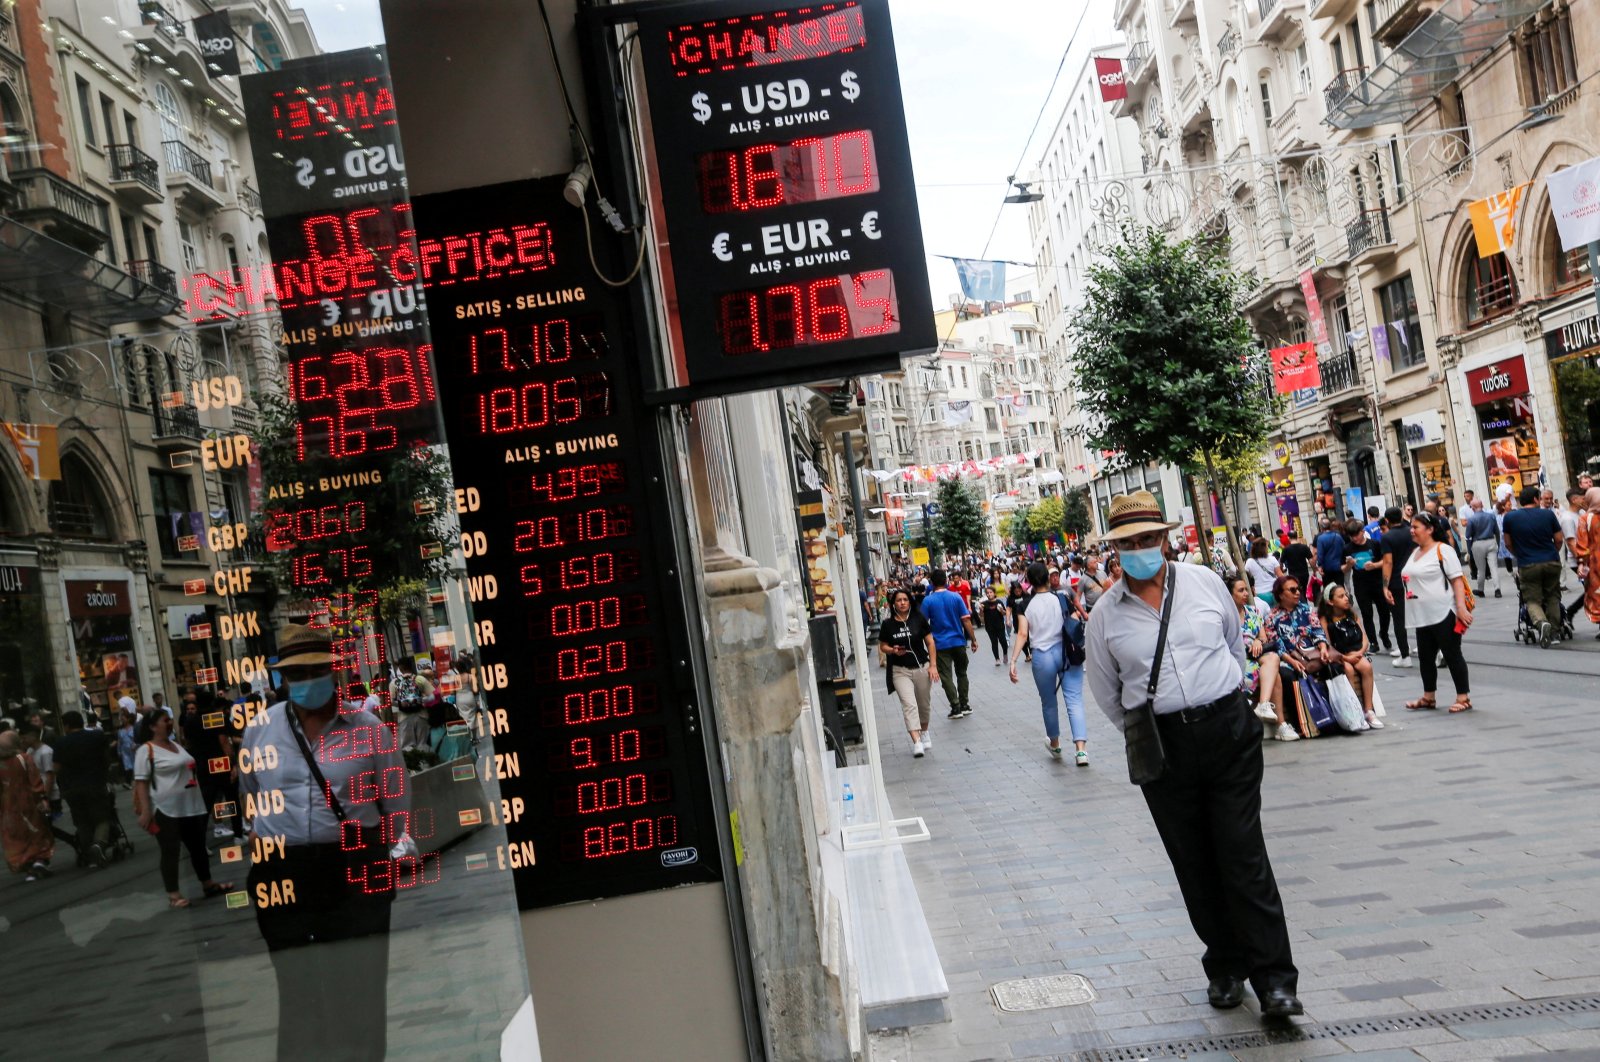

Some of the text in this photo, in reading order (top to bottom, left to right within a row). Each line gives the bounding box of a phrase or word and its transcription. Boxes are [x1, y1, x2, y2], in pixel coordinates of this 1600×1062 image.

[679, 14, 850, 63] CHANGE
[741, 78, 810, 114] USD
[729, 110, 830, 133] ALIŞ BUYING
[761, 219, 832, 255] EUR
[194, 227, 544, 312] CHANGE OFFICE
[750, 250, 850, 273] ALIŞ BUYING
[455, 287, 586, 318] SATIŞ SELLING
[281, 316, 393, 345] ALIŞ BUYING
[193, 376, 242, 411] USD
[1480, 374, 1509, 393] TUDORS
[1482, 419, 1511, 431] TUDORS
[201, 435, 251, 472] EUR
[505, 434, 619, 463] ALIŞ BUYING
[269, 470, 382, 500] ALIŞ BUYING
[446, 487, 480, 513] ED
[207, 523, 248, 552] GBP
[457, 531, 488, 558] OD
[214, 567, 252, 596] CHF
[220, 611, 261, 640] DKK
[226, 655, 269, 685] NOK
[231, 701, 270, 730] SEK
[239, 745, 278, 774] CAD
[246, 789, 285, 819] AUD
[251, 834, 286, 864] JPY
[256, 878, 296, 909] SAR
